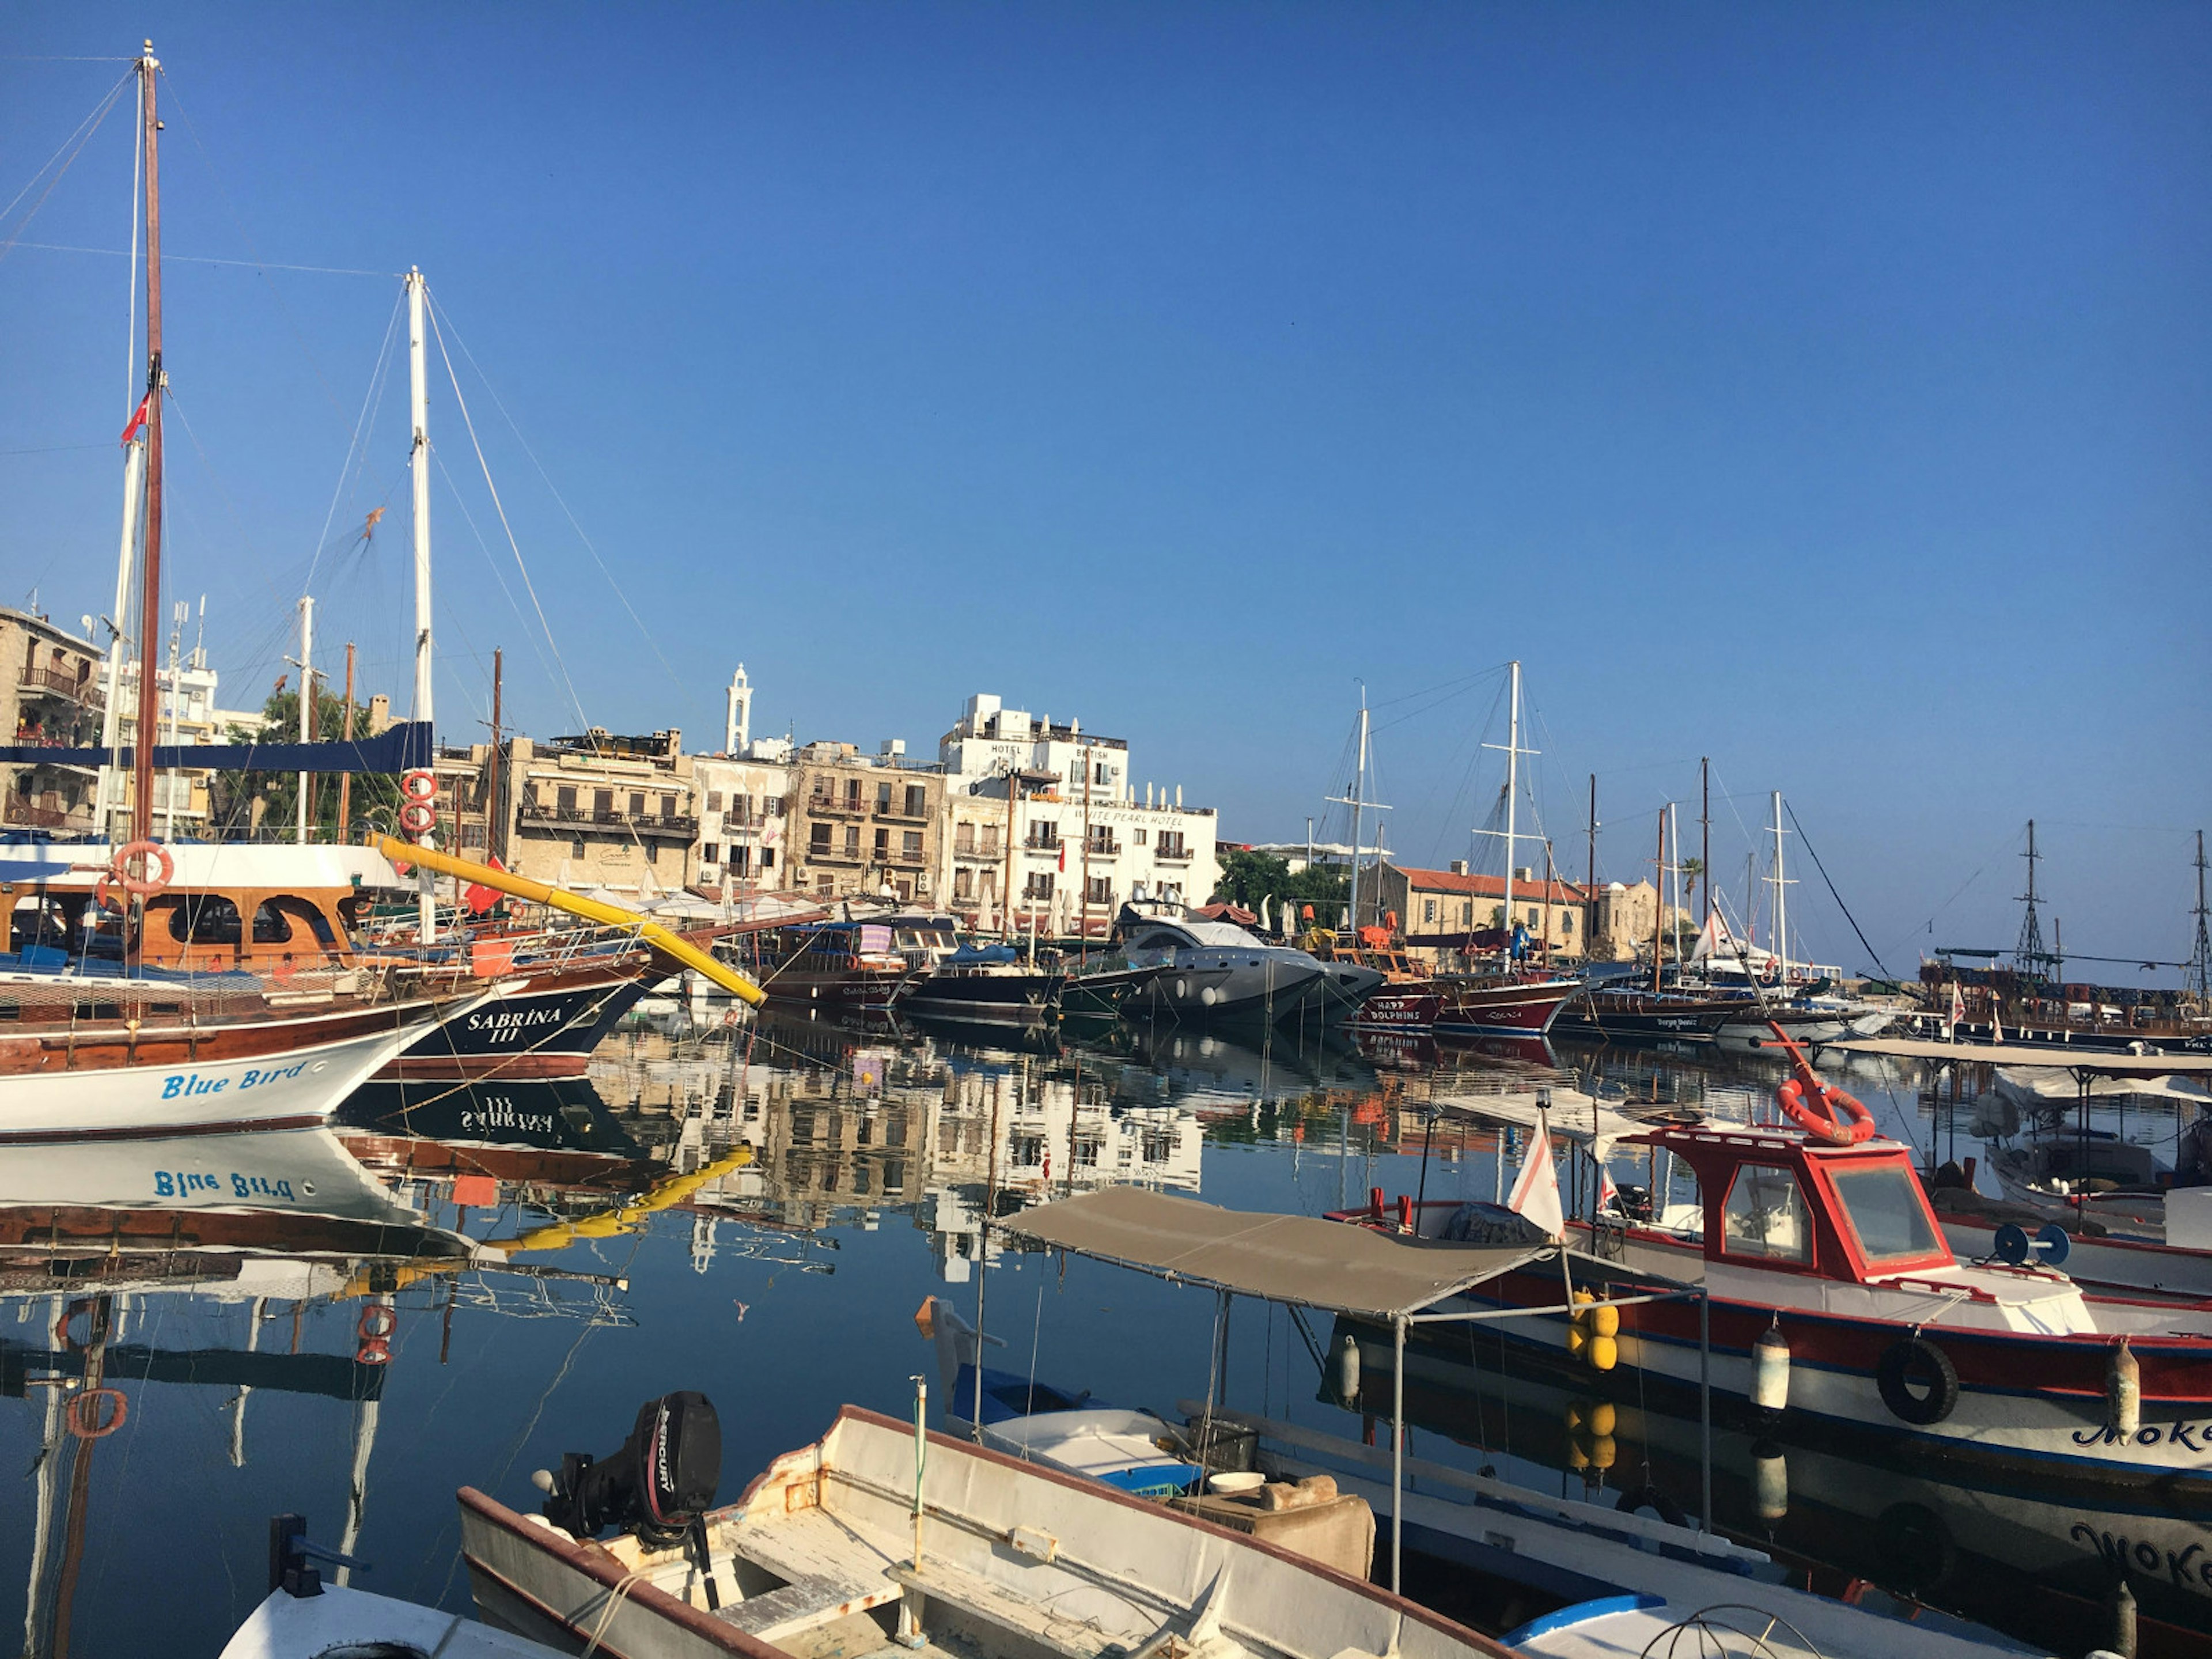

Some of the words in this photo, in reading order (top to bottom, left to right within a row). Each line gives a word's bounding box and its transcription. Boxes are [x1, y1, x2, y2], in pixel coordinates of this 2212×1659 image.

[1113, 812, 1146, 823] PEARL
[1151, 816, 1183, 826] HOTEL
[1371, 1012, 1419, 1020] DOLPHINS
[161, 1074, 229, 1099] Blue
[658, 1405, 671, 1493] MERCURY
